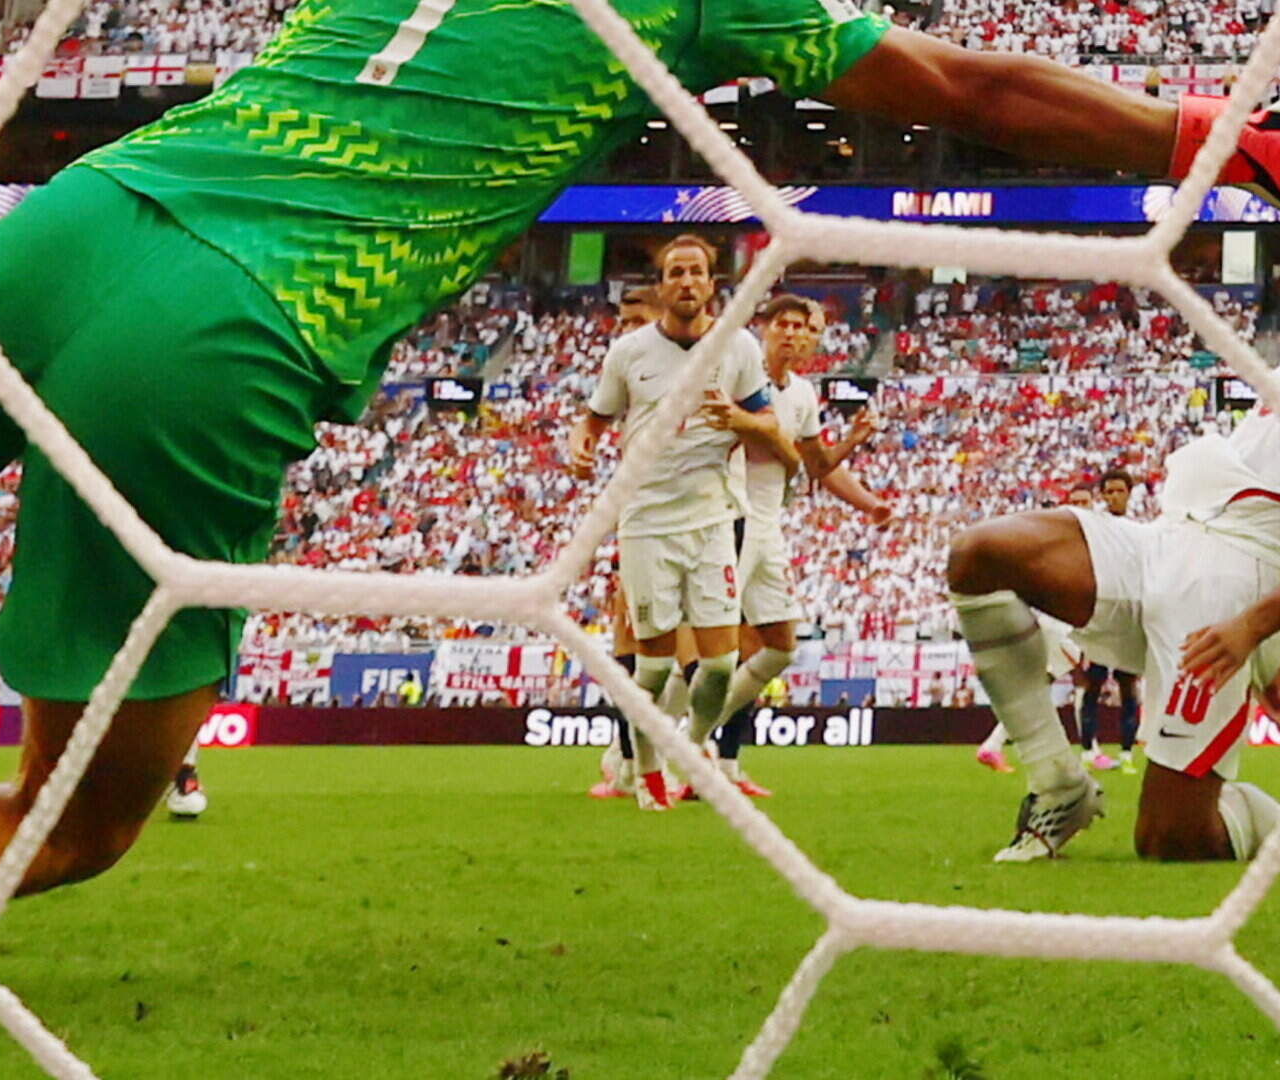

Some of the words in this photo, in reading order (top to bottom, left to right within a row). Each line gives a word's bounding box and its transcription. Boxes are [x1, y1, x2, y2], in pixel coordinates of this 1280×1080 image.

[892, 191, 992, 217] MIAMI
[723, 564, 737, 599] 9
[451, 674, 497, 689] STILL
[1165, 674, 1216, 725] 10
[754, 707, 815, 746] for
[823, 708, 873, 746] all
